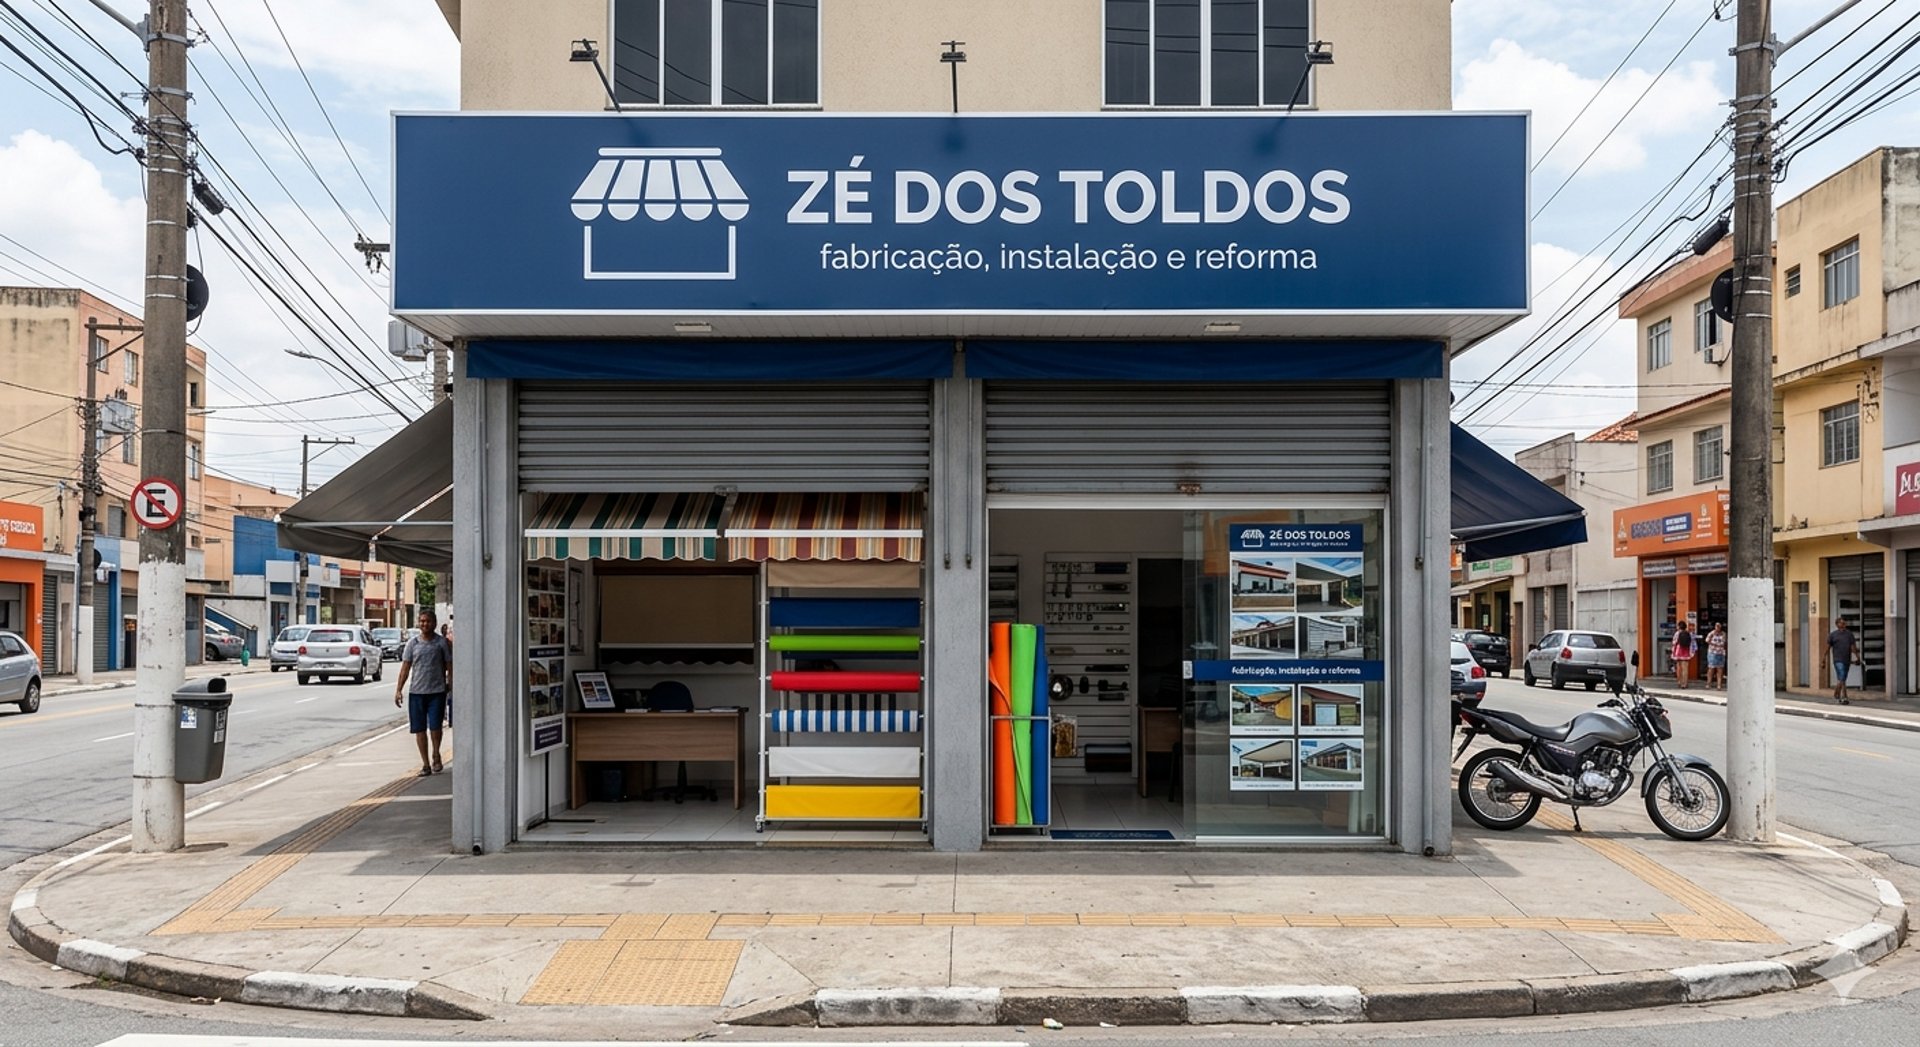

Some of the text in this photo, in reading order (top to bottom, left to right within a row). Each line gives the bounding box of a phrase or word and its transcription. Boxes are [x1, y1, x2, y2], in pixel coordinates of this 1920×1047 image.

[786, 155, 1351, 225] ZÉ DOS TOLDOS
[819, 242, 1318, 275] fabricação, instalação e reforma
[146, 489, 167, 518] E
[1284, 530, 1307, 540] DOS
